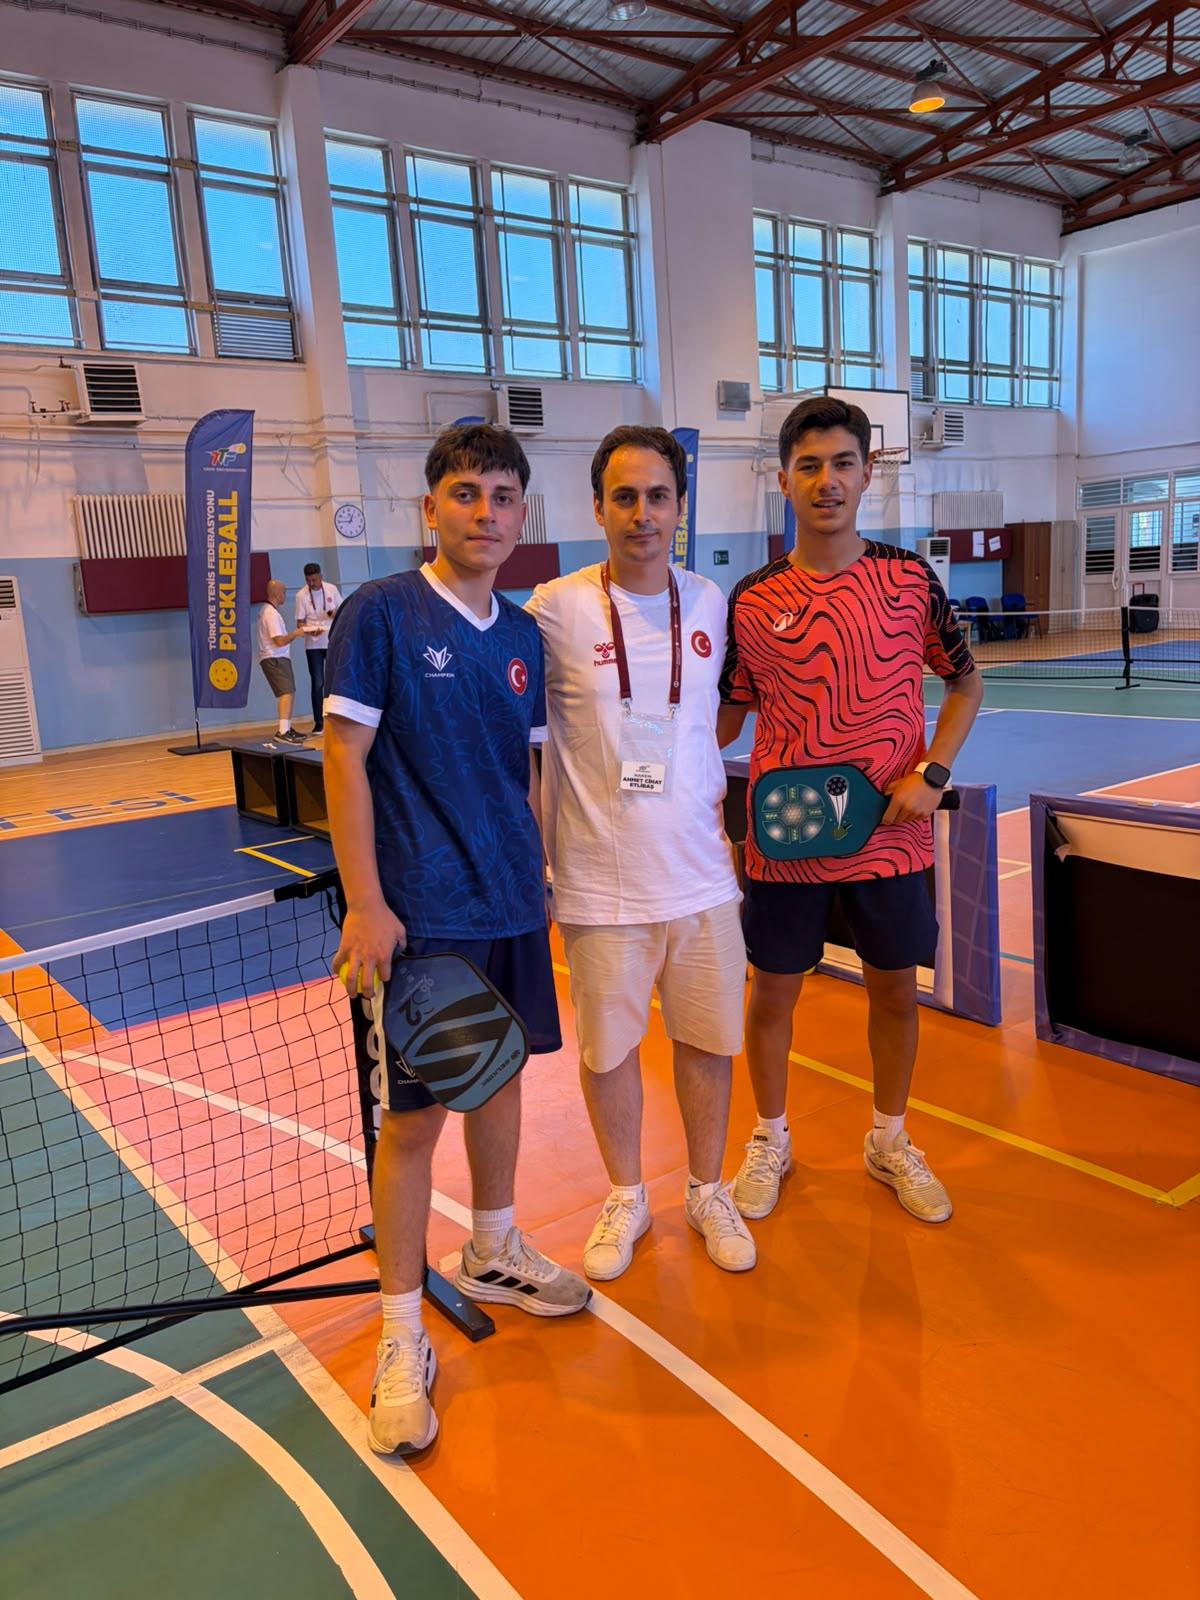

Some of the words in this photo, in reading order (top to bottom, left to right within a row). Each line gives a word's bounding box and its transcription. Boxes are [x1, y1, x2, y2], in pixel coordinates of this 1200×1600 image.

[206, 489, 216, 569] FEDERASYONU
[206, 571, 216, 602] TENİS
[218, 490, 238, 650] PICKLEBALL
[207, 605, 217, 650] TÜRKİYE
